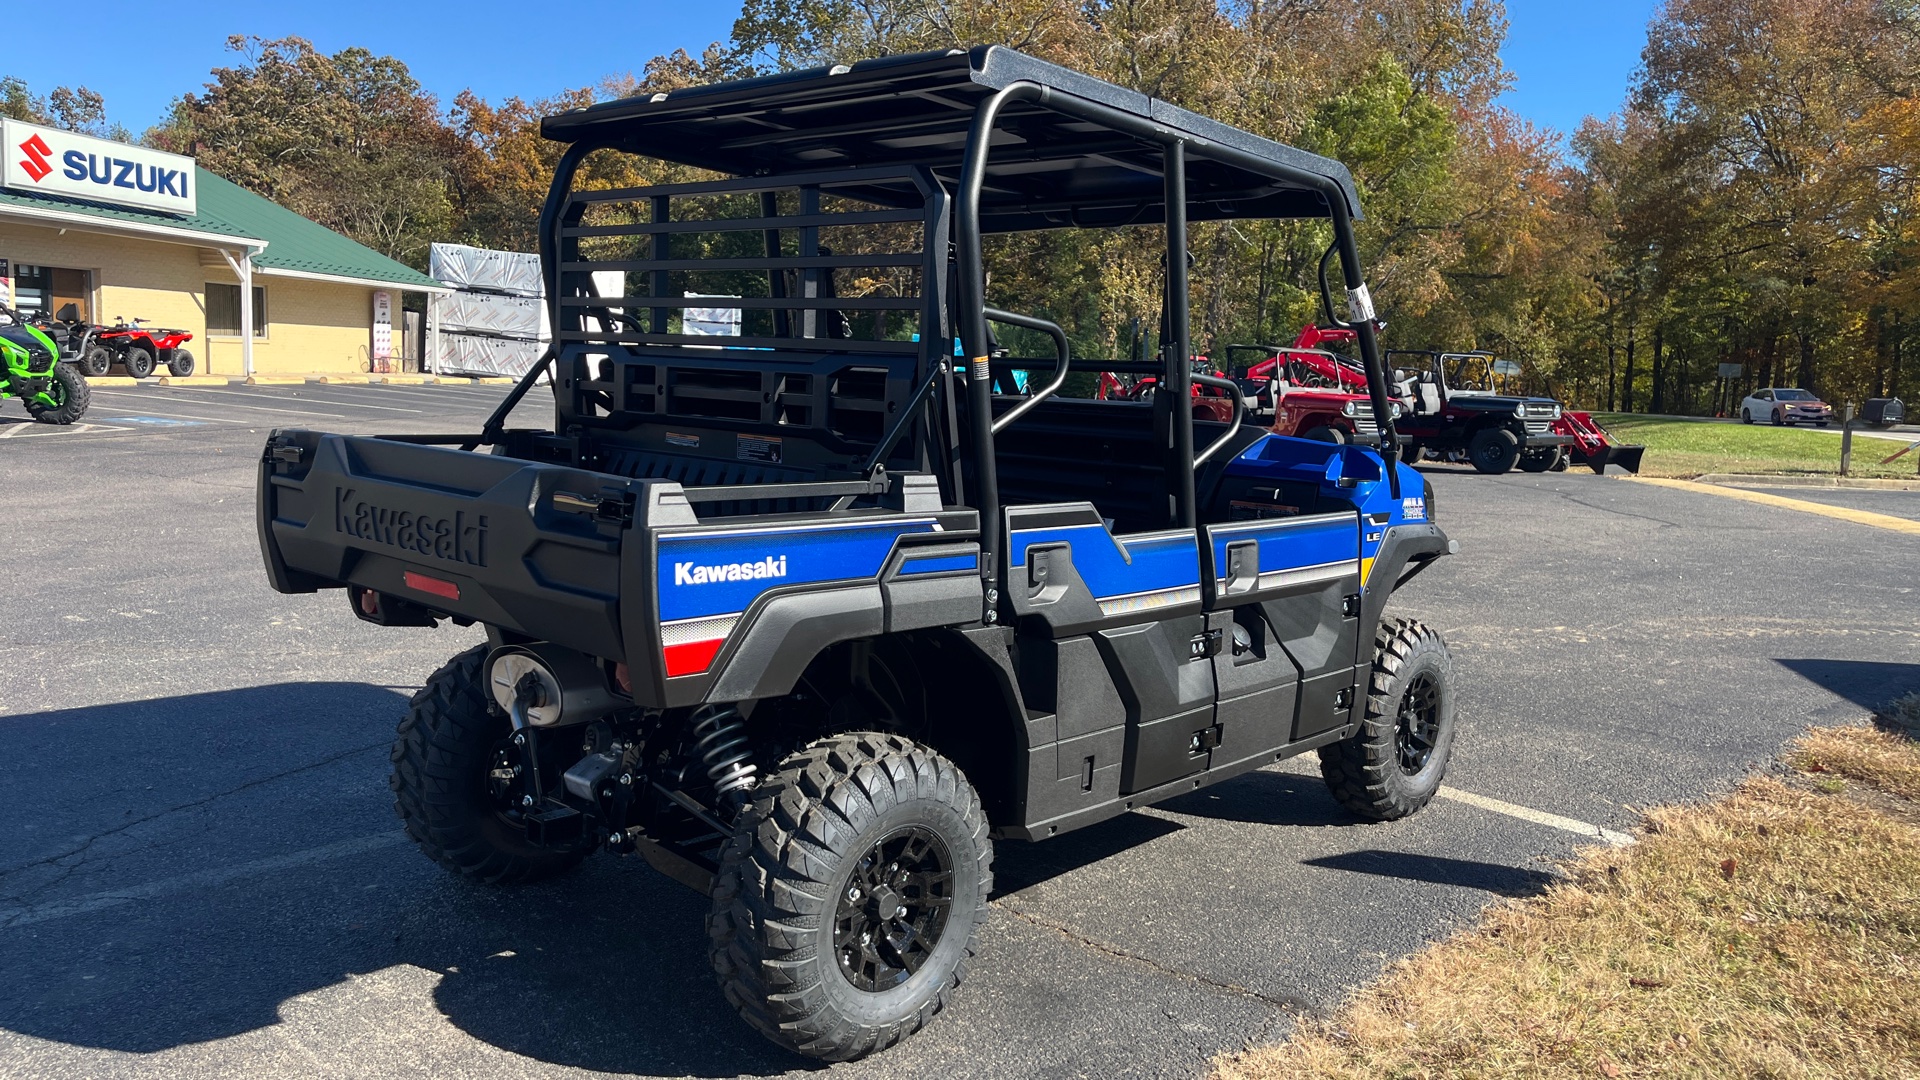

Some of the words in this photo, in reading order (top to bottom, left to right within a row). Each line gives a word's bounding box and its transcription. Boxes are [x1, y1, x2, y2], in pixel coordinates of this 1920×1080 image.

[63, 150, 188, 198] SUZUKI
[335, 486, 488, 568] Kawasaki
[1366, 533, 1380, 542] LE
[674, 555, 787, 586] Kawasaki
